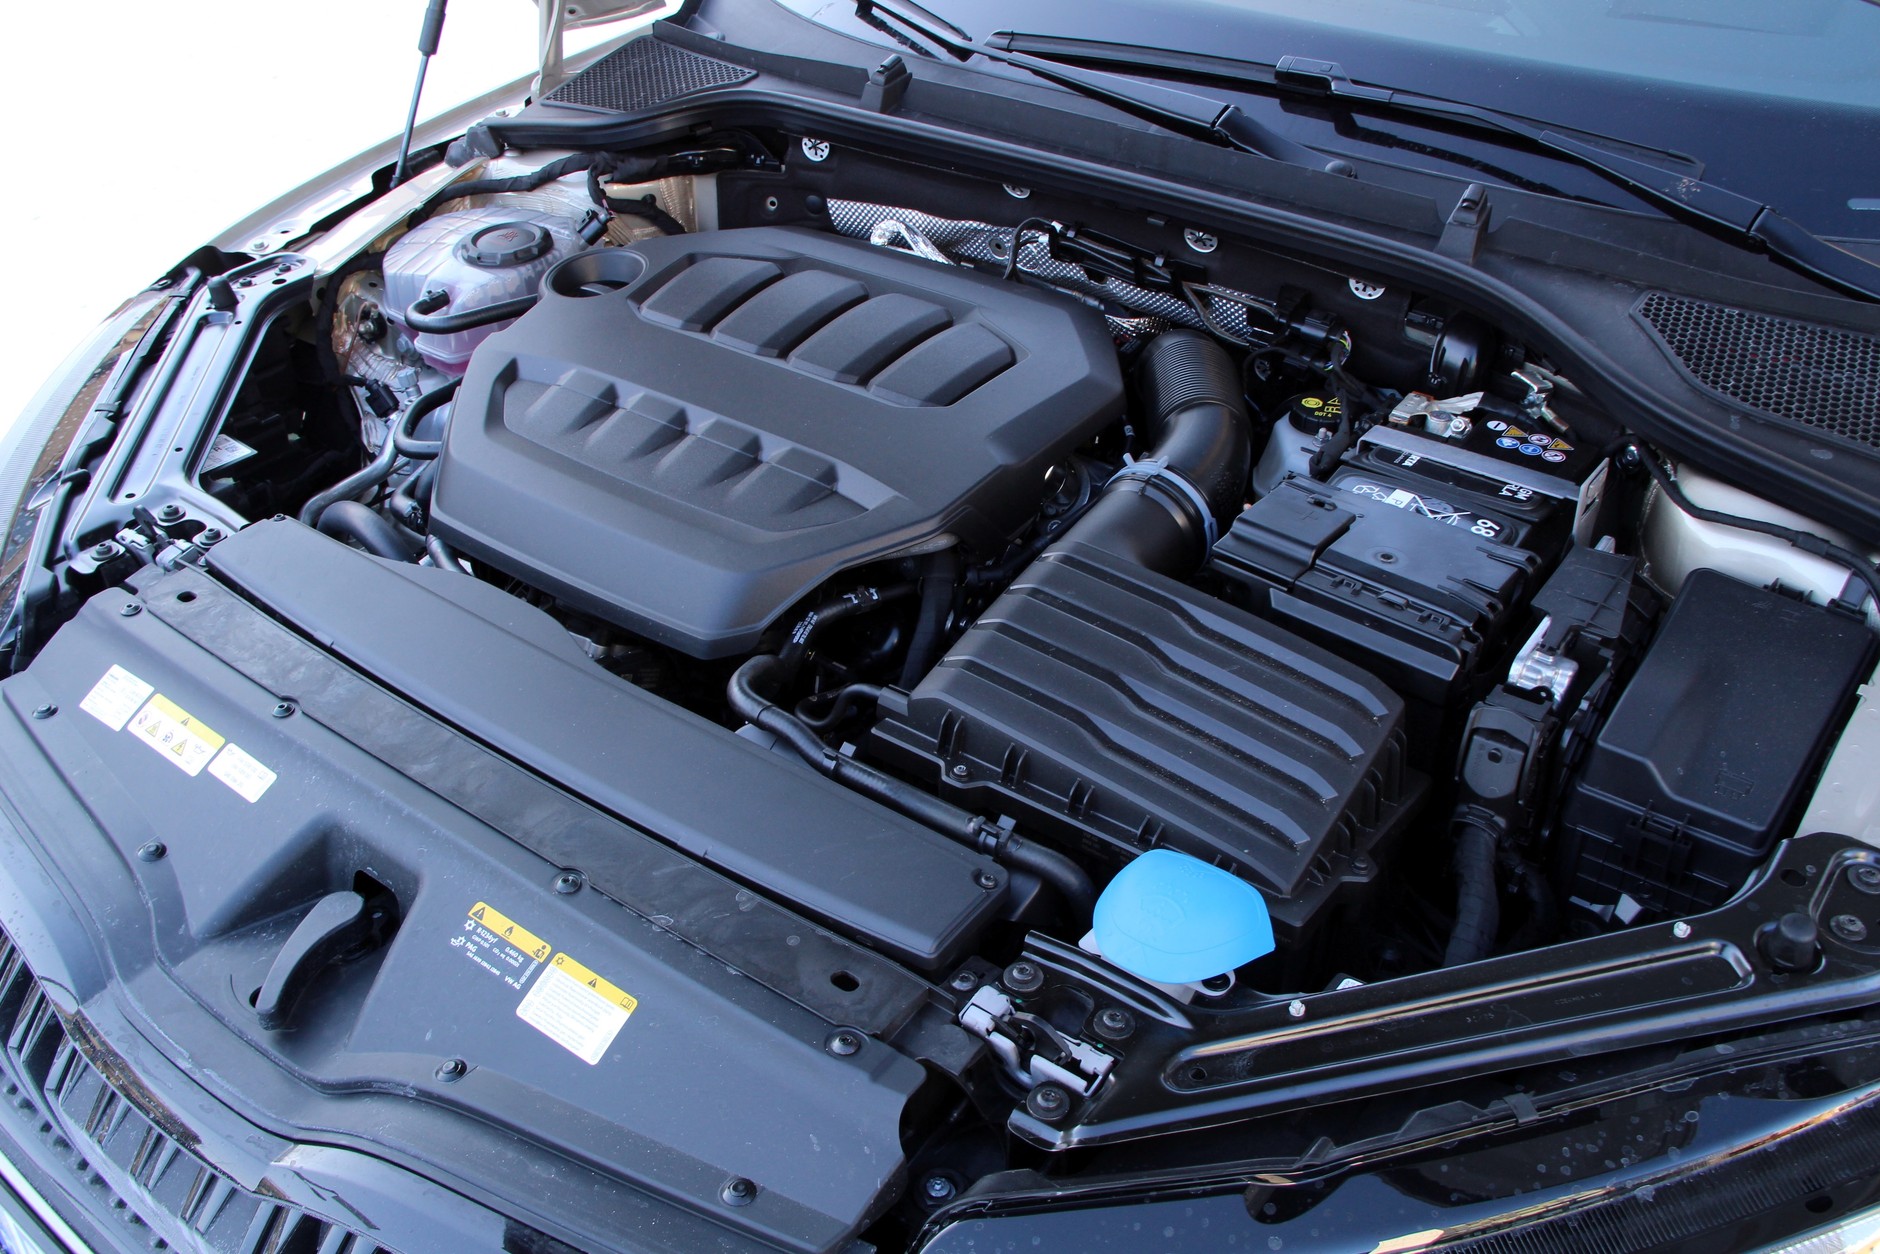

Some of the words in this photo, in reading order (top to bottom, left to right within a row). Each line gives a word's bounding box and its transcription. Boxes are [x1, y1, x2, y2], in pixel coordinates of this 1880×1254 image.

[1401, 454, 1421, 467] RTA
[1498, 484, 1520, 496] RLA
[1513, 488, 1533, 501] GM
[465, 942, 478, 952] PAG
[517, 954, 525, 963] kg
[504, 975, 515, 985] VW
[512, 981, 522, 990] AG
